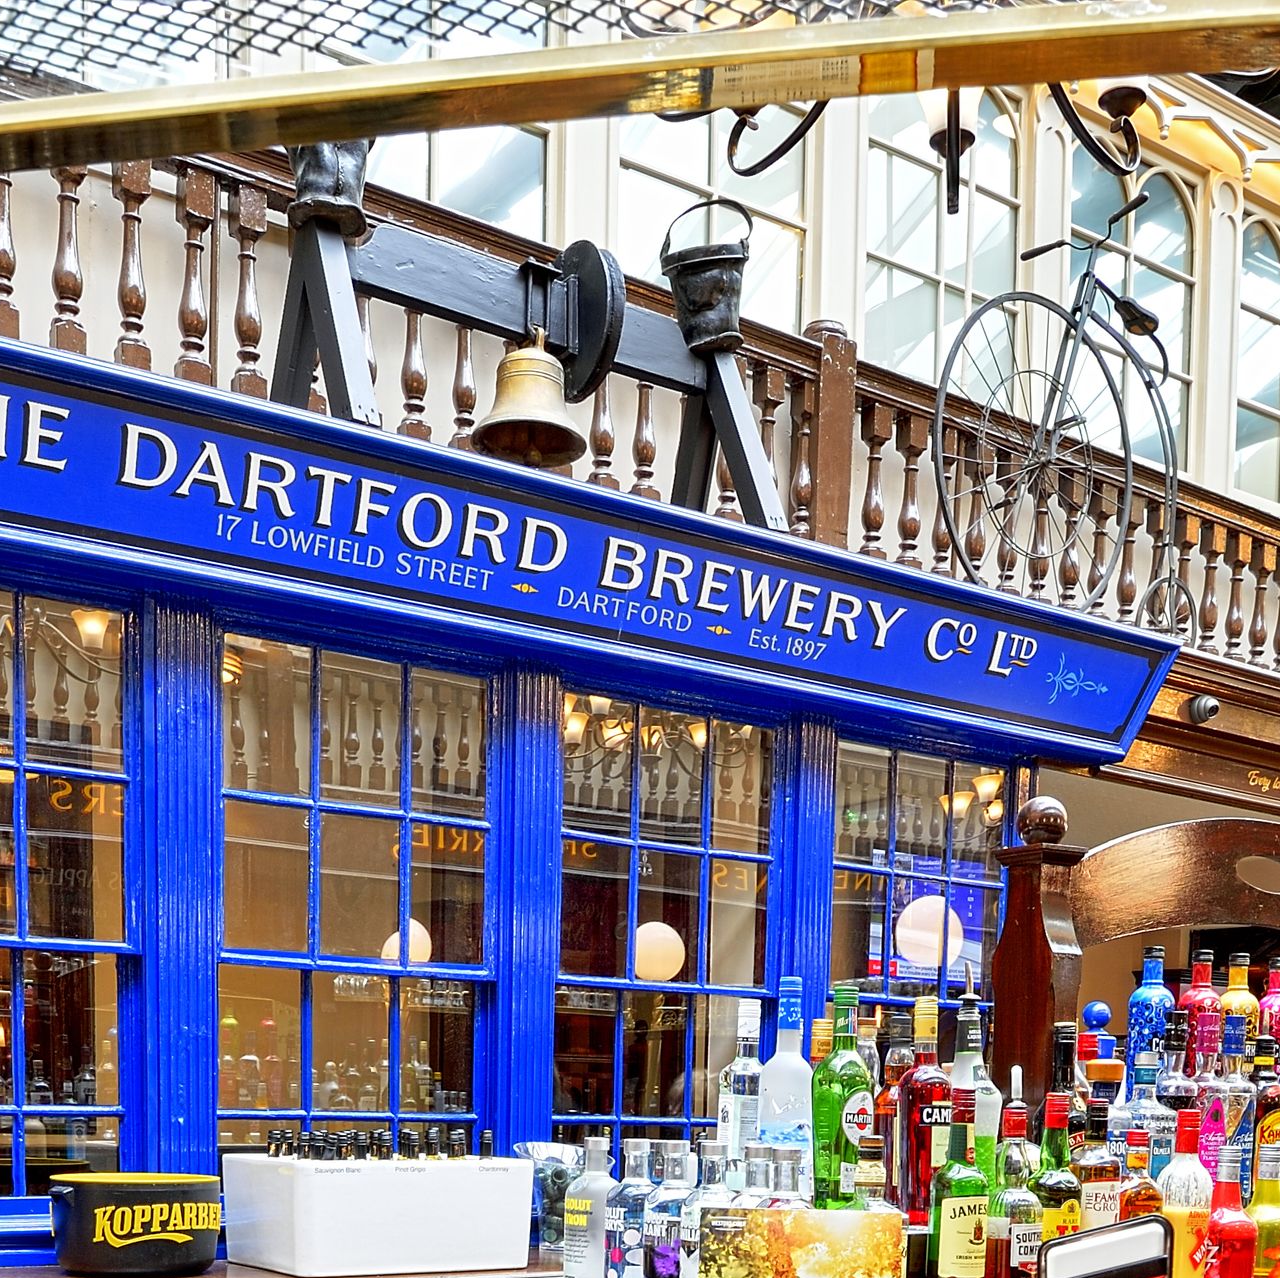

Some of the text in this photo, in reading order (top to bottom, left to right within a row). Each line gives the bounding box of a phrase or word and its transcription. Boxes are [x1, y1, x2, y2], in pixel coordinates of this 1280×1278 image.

[120, 422, 569, 573] DARTFORD
[601, 536, 908, 648] BREWERY
[216, 513, 238, 541] 17
[251, 522, 385, 569] LOWFIELD
[397, 553, 495, 591] STREET
[557, 585, 693, 633] DARTFORD
[785, 636, 827, 662] 1897
[1247, 770, 1272, 791] Every
